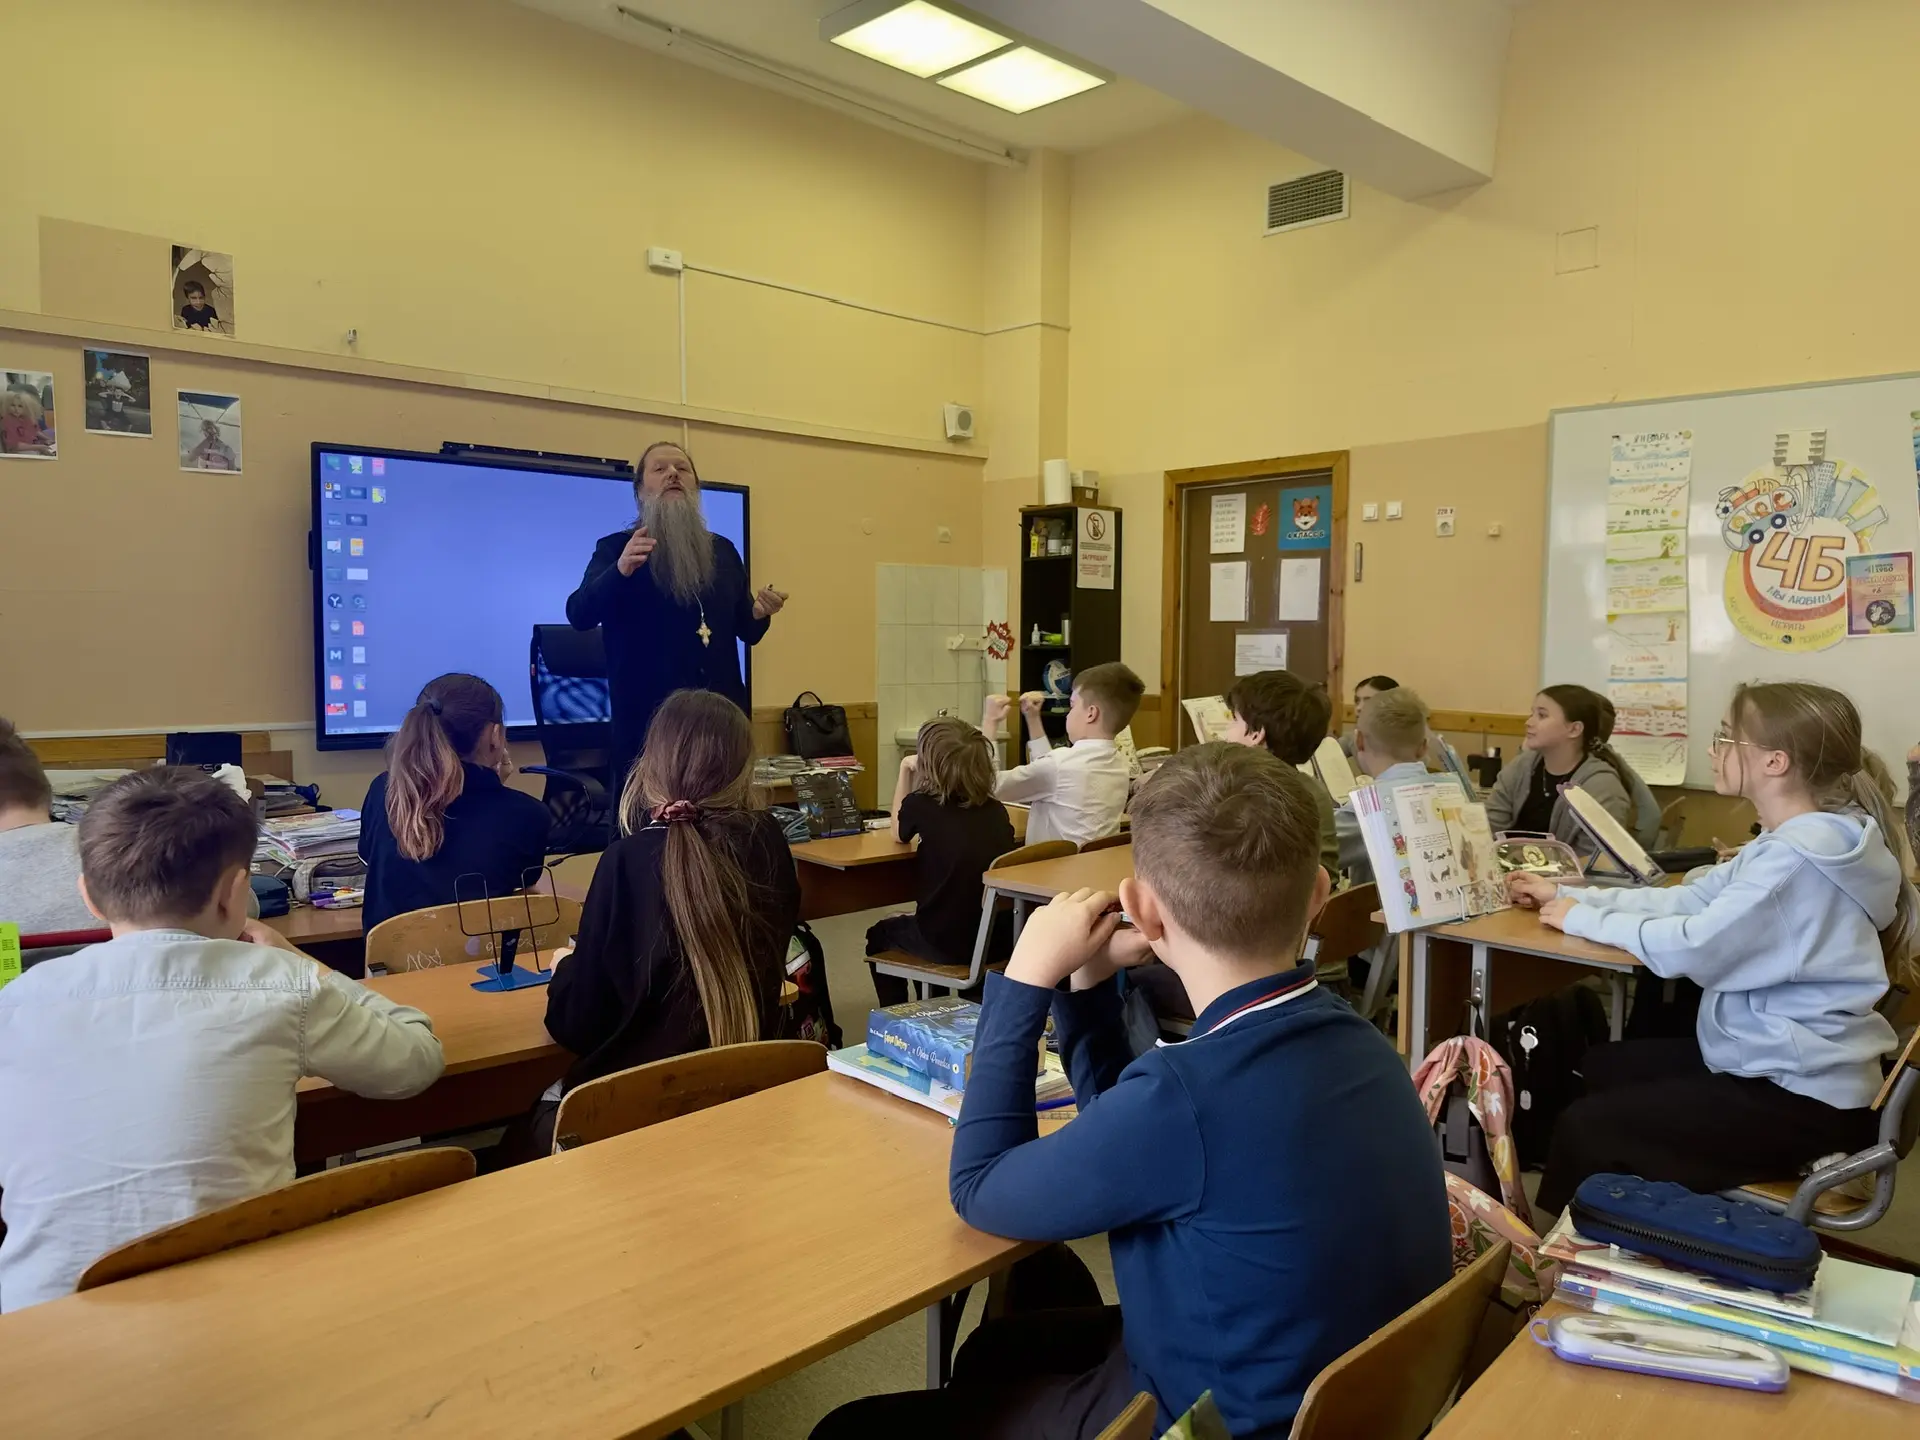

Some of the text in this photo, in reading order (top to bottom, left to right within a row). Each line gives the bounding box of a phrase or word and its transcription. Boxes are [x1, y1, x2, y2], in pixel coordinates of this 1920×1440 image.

[1756, 531, 1846, 592] 4Б
[1766, 586, 1832, 606] МЫ ЛЮБИМ
